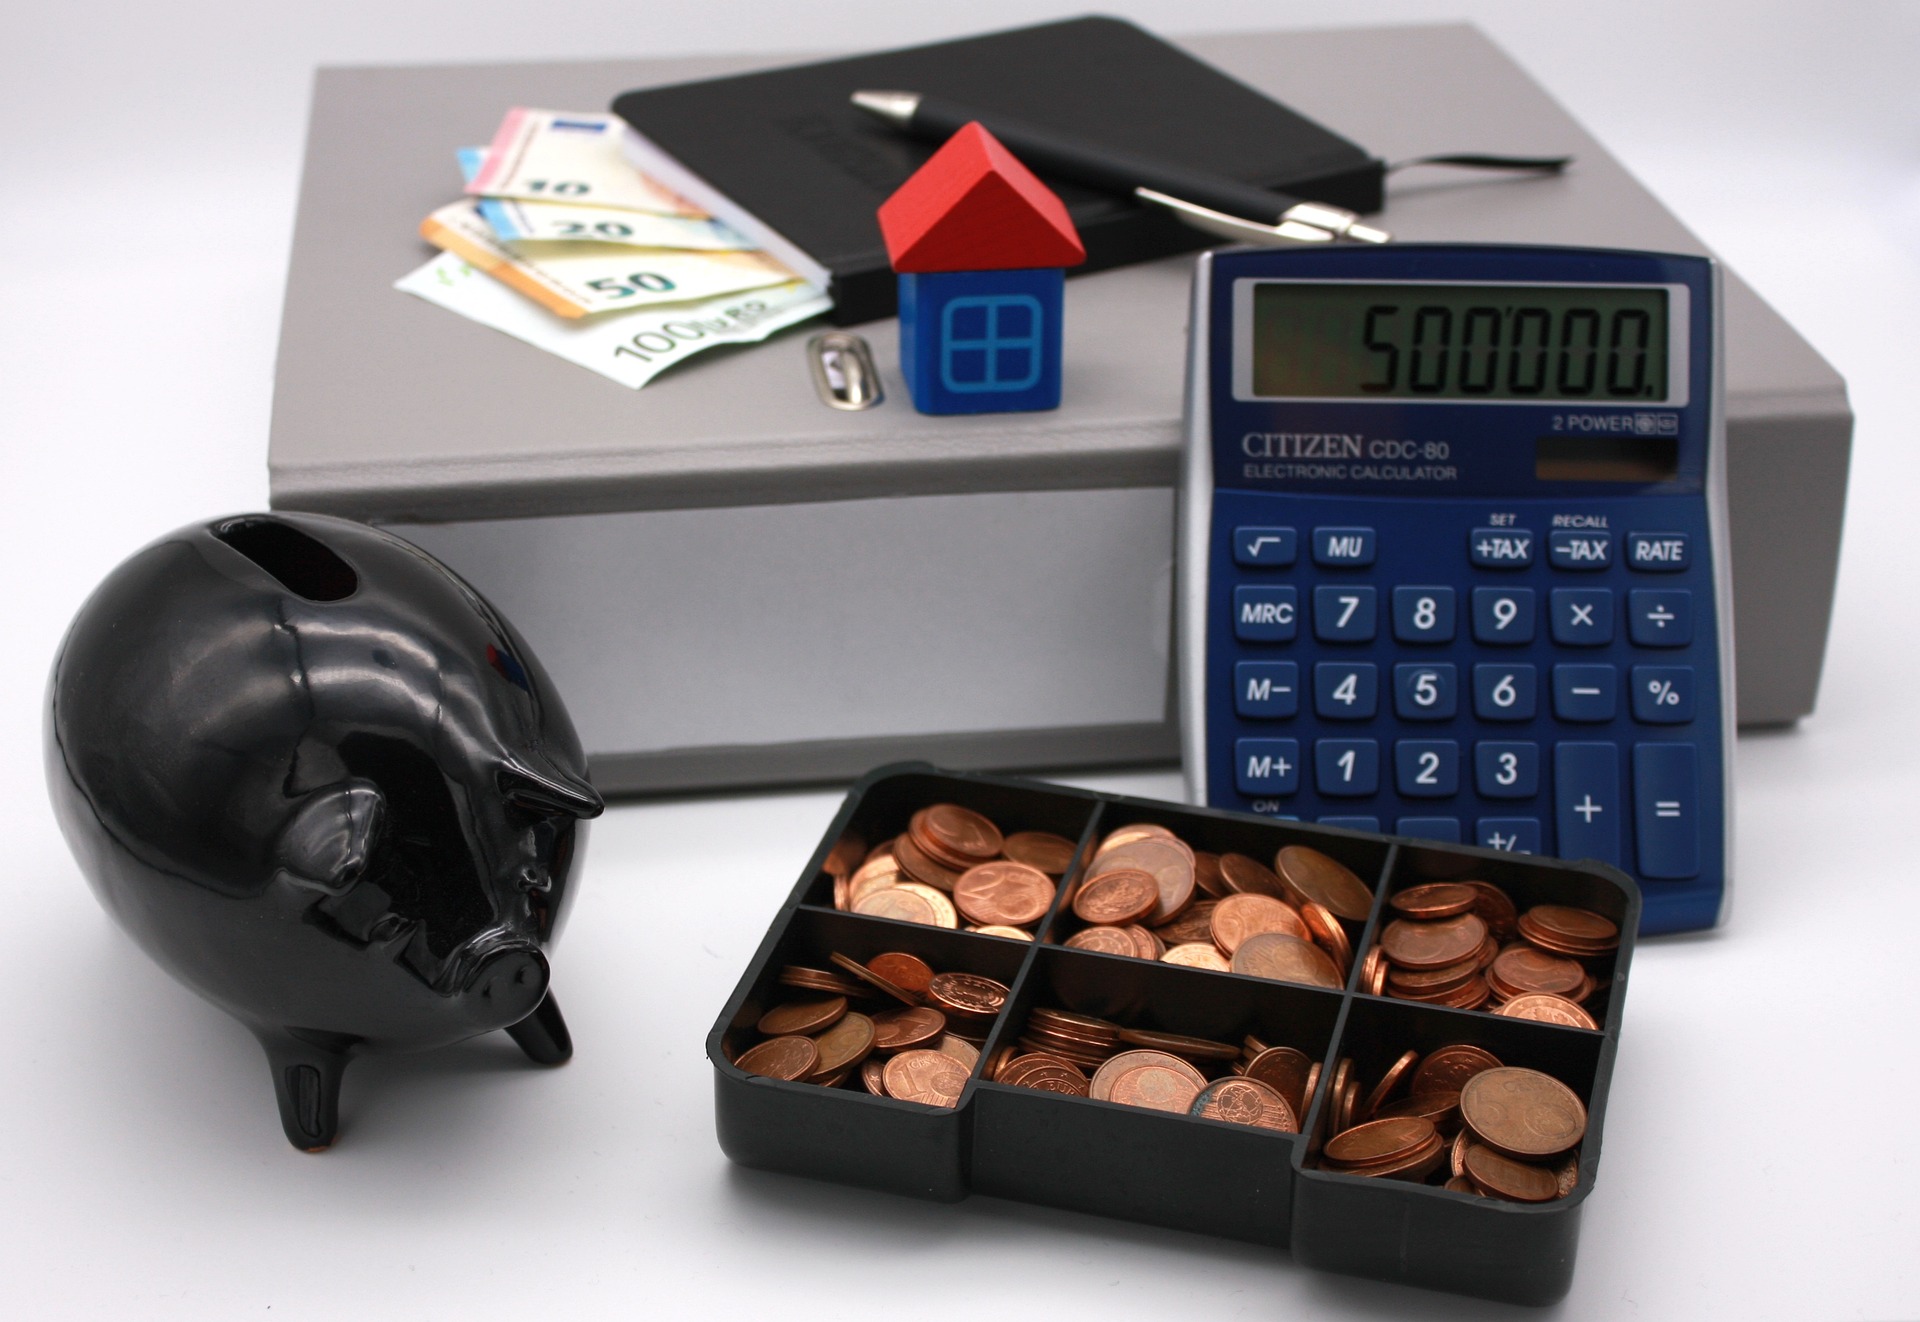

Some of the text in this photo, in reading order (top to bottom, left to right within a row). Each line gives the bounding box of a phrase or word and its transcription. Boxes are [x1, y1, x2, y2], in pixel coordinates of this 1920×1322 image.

[524, 179, 592, 196] 10
[551, 220, 635, 239] 20
[585, 272, 677, 300] 50
[1553, 414, 1634, 432] 2 POWER
[1242, 432, 1450, 460] CITIZEN CDC-80
[1243, 463, 1457, 481] ELECTRONIC CALCULATOR
[1490, 512, 1517, 527] SET
[1552, 514, 1609, 529] RECALL
[1328, 536, 1363, 558] MU
[1476, 538, 1530, 560] +TAX
[1635, 540, 1684, 561] RATE
[1241, 602, 1294, 624] MRC
[1337, 596, 1360, 628] 7
[1413, 597, 1437, 630] 8
[1493, 598, 1518, 630] 9
[1332, 673, 1358, 705] 4
[1414, 673, 1438, 706] 5
[1492, 674, 1516, 707] 6
[1247, 755, 1292, 778] M+
[1337, 750, 1356, 782] 1
[1415, 751, 1440, 784] 2
[1496, 752, 1518, 785] 3
[1252, 801, 1280, 813] ON
